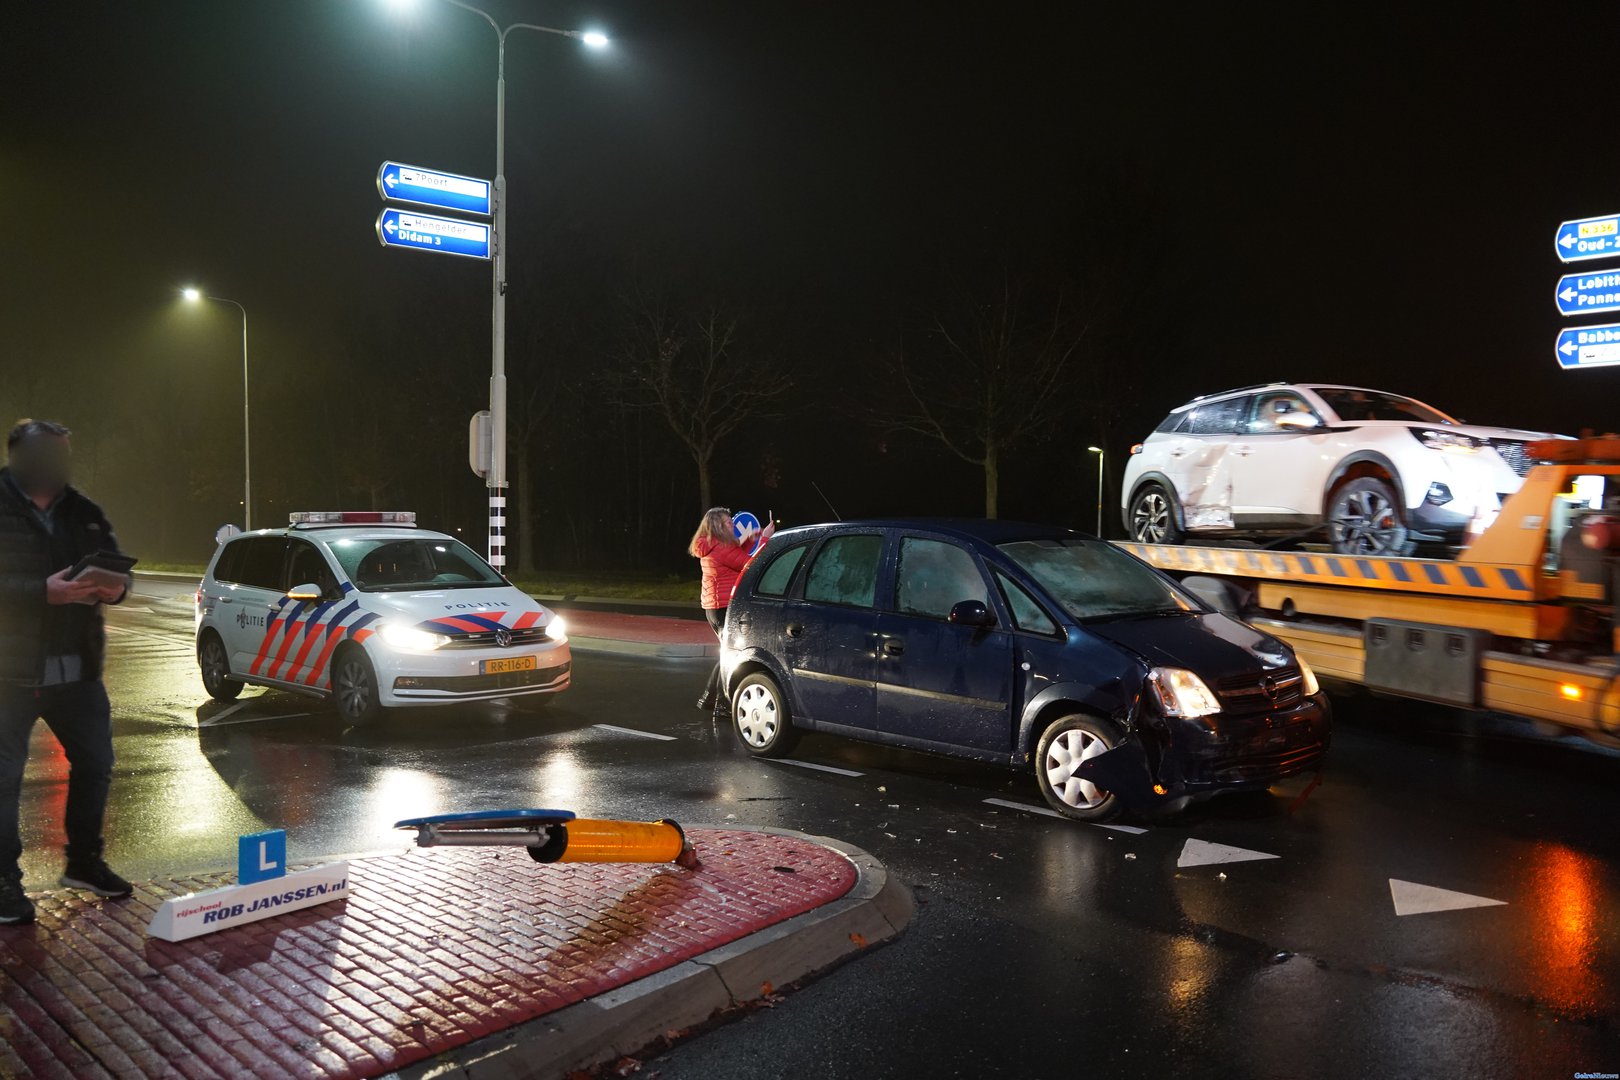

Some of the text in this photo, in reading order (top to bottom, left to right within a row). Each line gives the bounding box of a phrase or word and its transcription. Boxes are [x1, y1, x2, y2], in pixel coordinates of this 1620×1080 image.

[415, 172, 448, 187] 7Poort
[398, 230, 442, 245] Didam 3
[444, 601, 511, 611] POLITIE
[490, 658, 531, 672] RR-116-D
[259, 841, 277, 872] L
[203, 878, 346, 924] ROB JANSSEN.nl
[177, 901, 222, 918] rijschool
